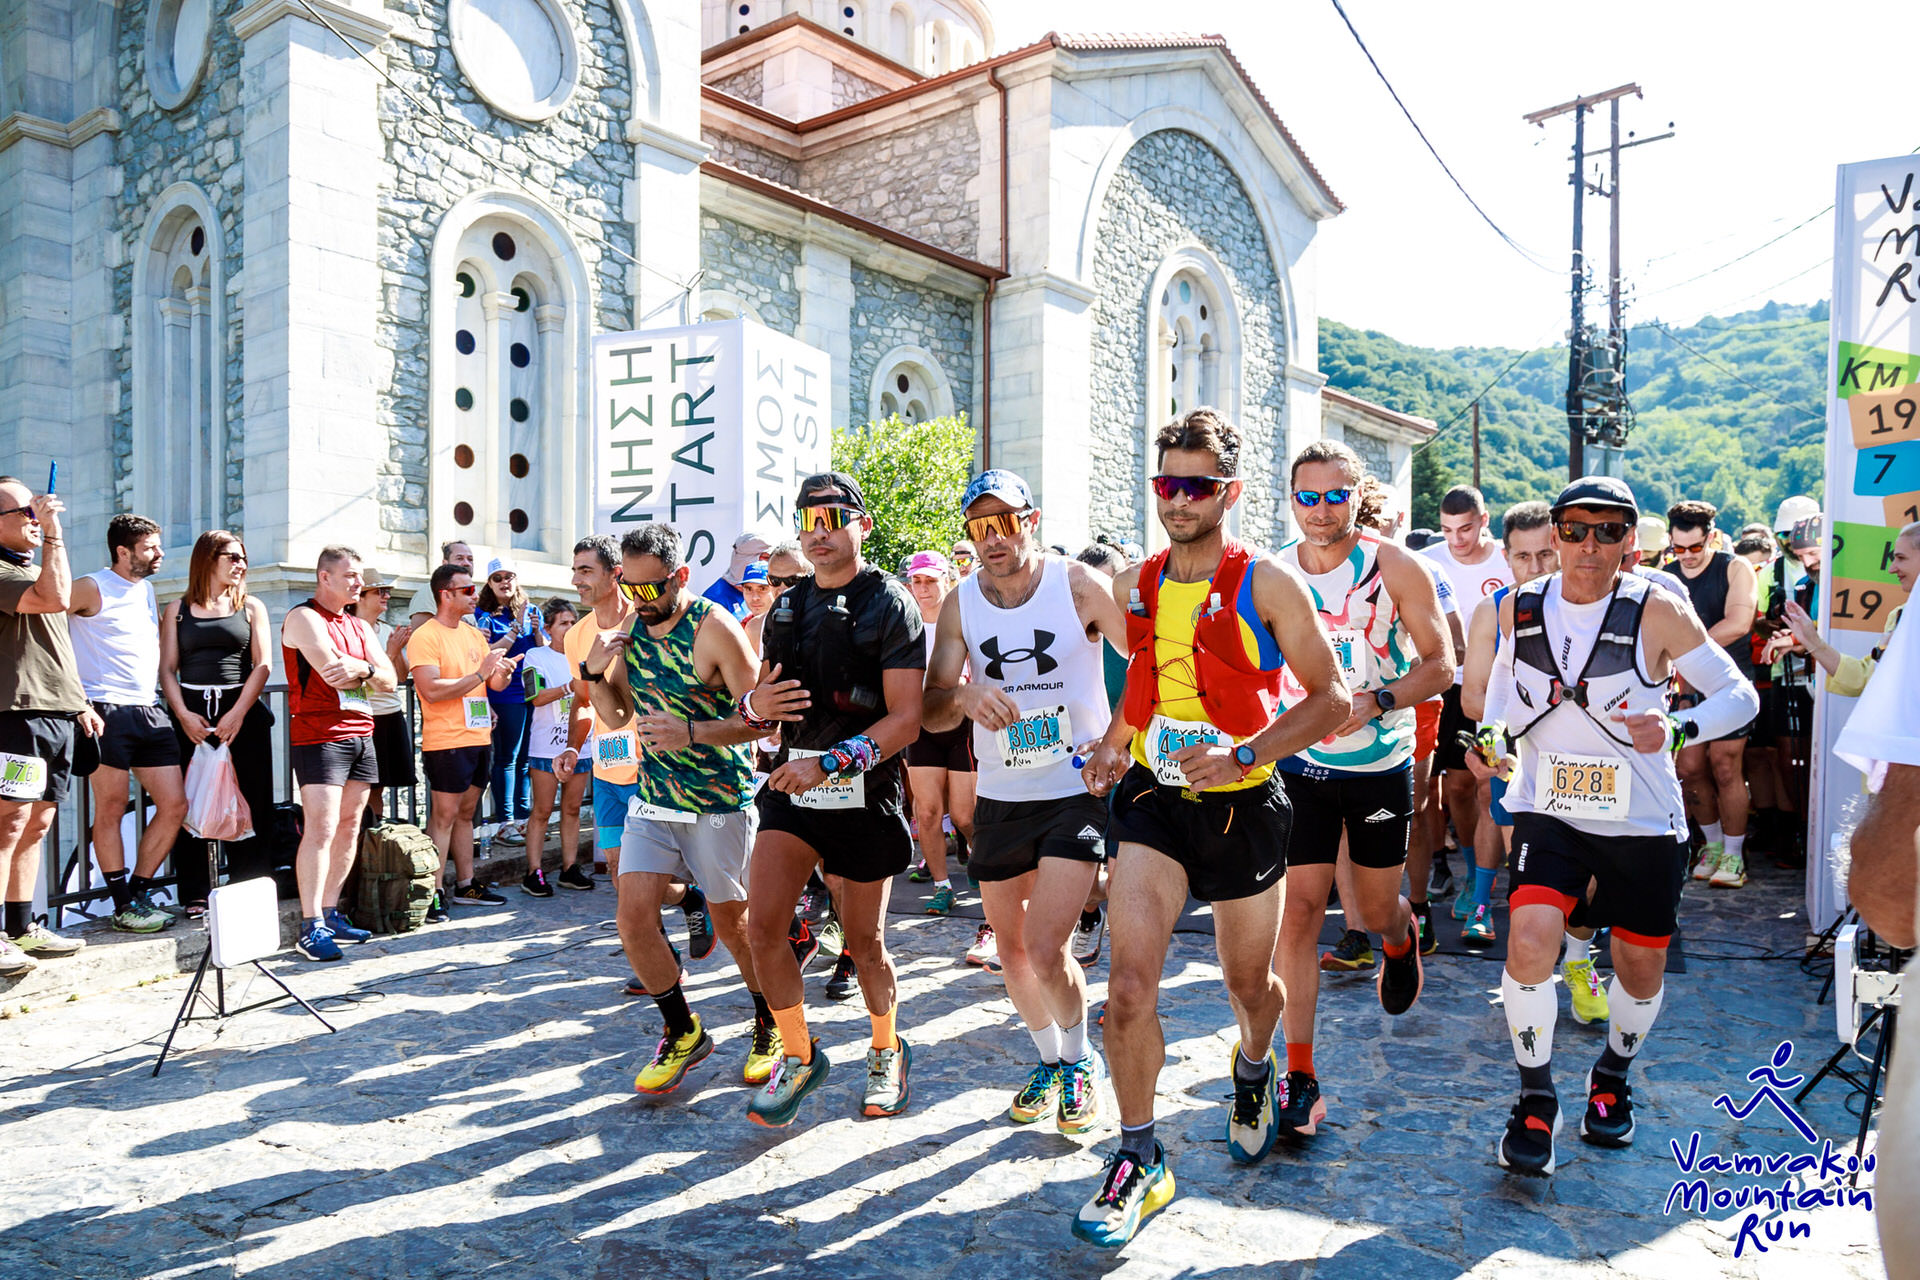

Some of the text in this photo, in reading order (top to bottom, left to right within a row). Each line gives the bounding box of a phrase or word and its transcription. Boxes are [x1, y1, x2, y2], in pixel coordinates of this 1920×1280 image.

[1839, 357, 1902, 393] KM
[1868, 398, 1917, 435] 19
[609, 345, 654, 524] ΝΗΣΗ
[756, 348, 784, 527] ΣΜΟΣ
[669, 342, 716, 567] START
[1873, 453, 1897, 484] 7
[1831, 588, 1883, 620] 19
[1016, 681, 1064, 692] ARMOUR
[1603, 687, 1632, 713] USWE
[1009, 720, 1053, 748] 364
[600, 739, 624, 759] 303
[1013, 755, 1032, 767] Run
[1156, 767, 1181, 782] Run
[1556, 768, 1603, 794] 628
[1545, 798, 1572, 812] Run
